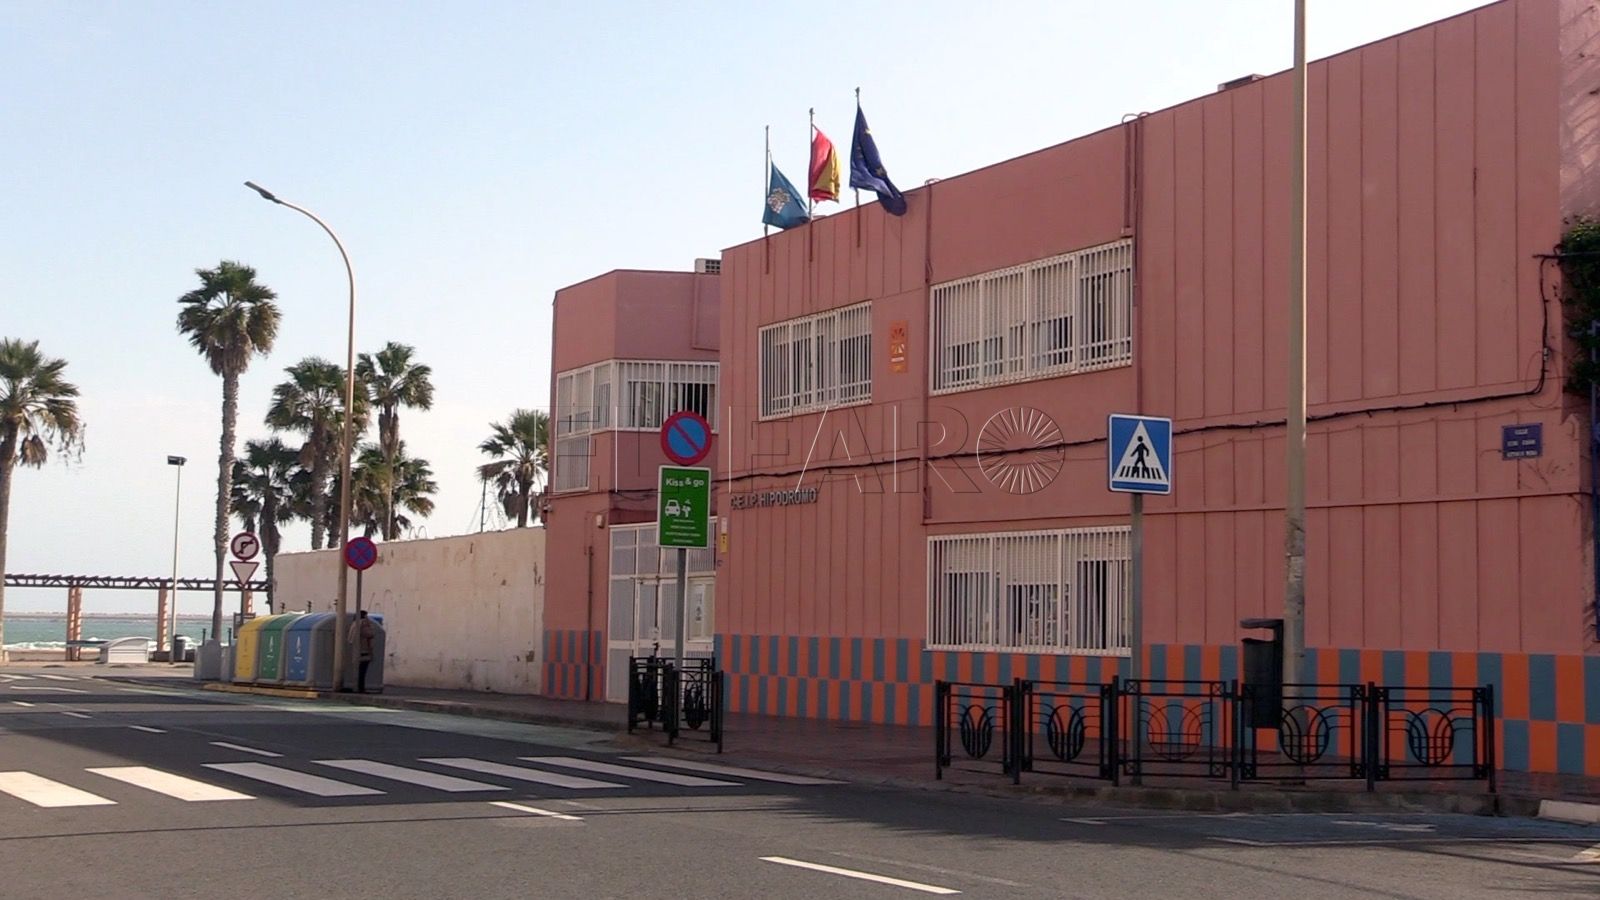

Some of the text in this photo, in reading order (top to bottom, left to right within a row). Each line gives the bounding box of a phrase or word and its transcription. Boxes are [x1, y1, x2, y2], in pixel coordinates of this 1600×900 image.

[666, 477, 705, 488] Kiss & go
